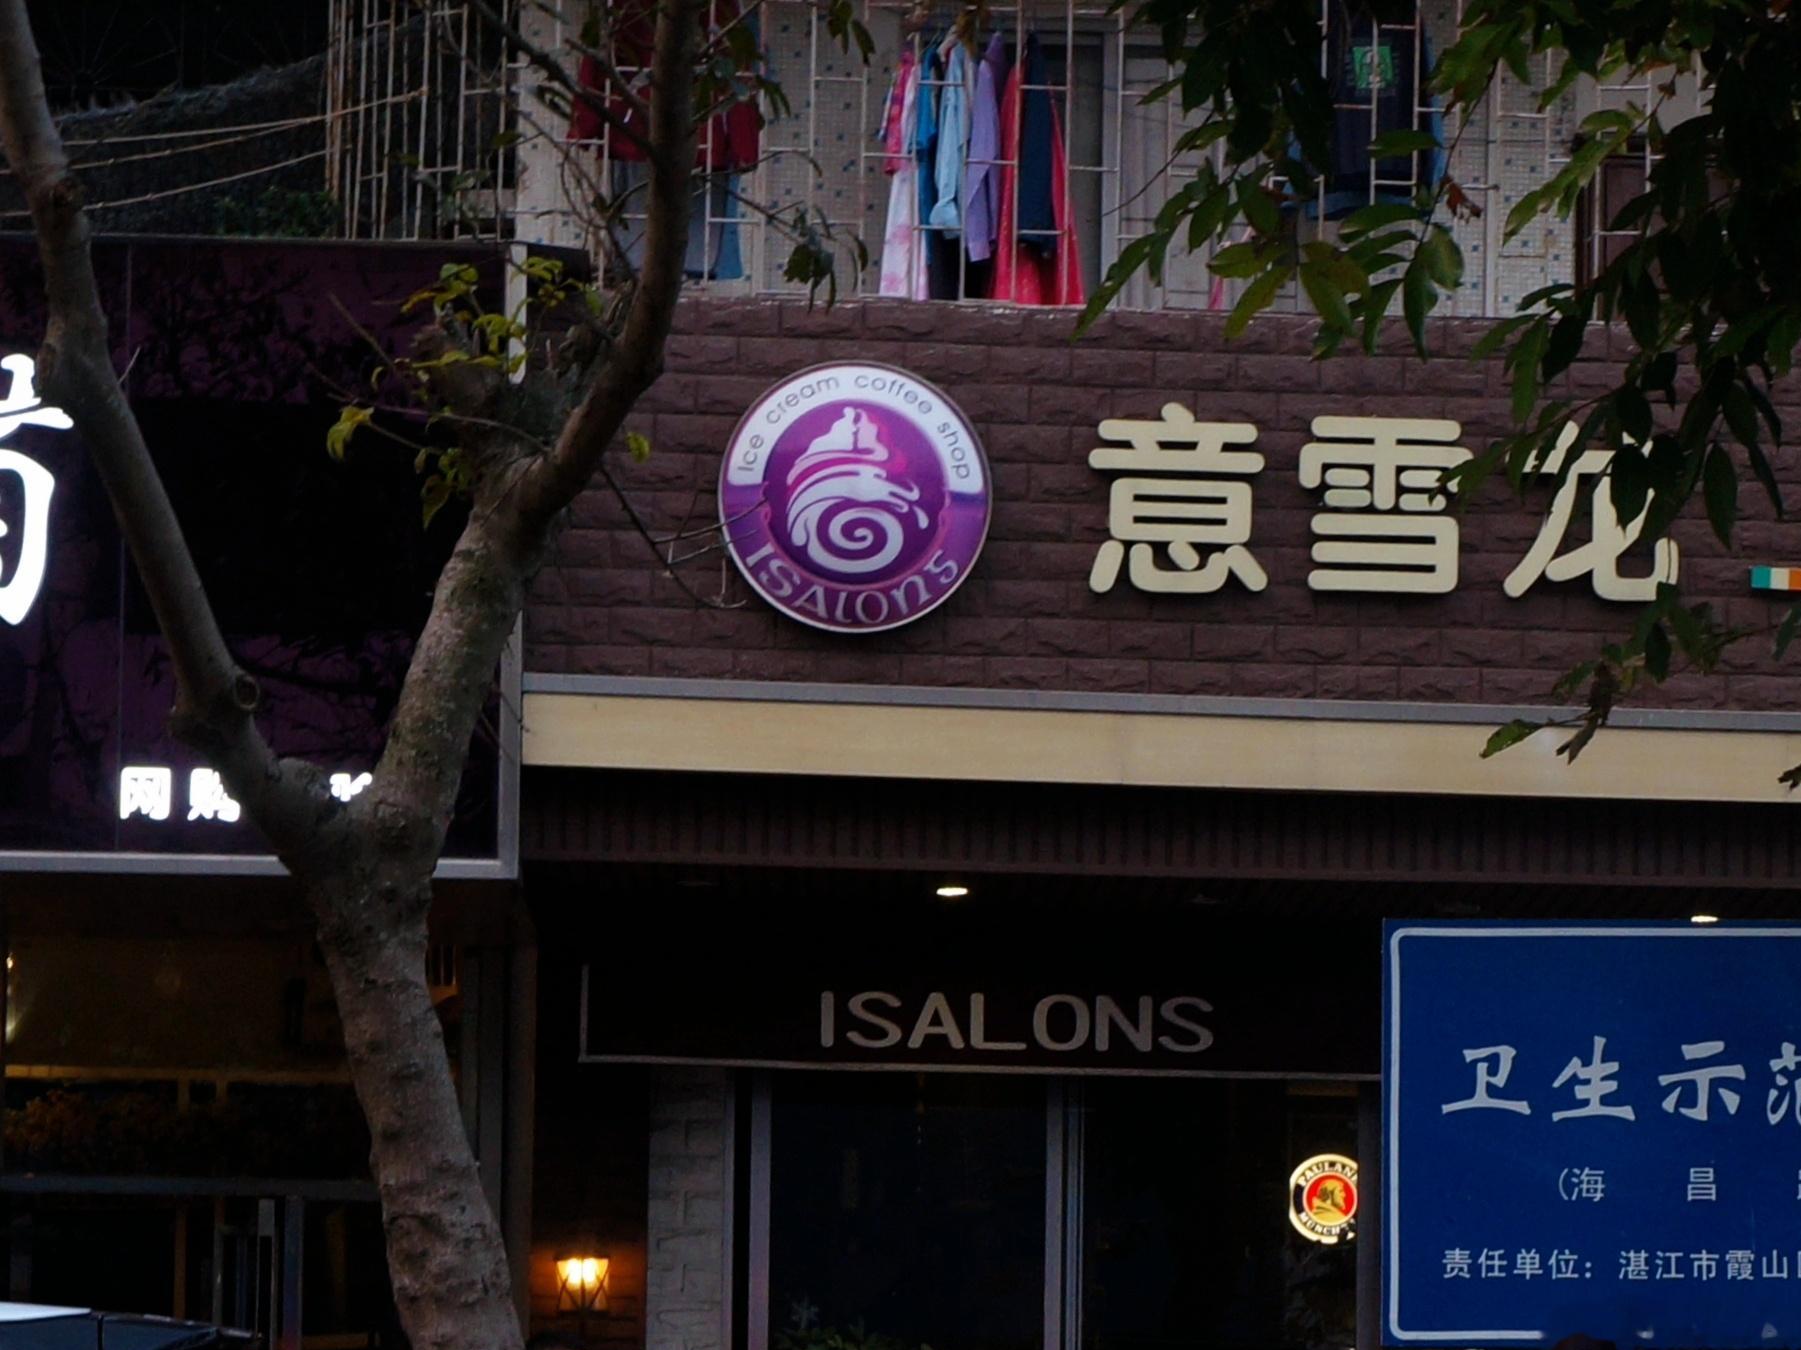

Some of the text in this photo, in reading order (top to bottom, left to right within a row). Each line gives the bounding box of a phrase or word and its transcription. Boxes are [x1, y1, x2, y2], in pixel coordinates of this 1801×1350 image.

[738, 374, 971, 480] Ice cream coffee shop
[821, 990, 1215, 1052] ISALONS
